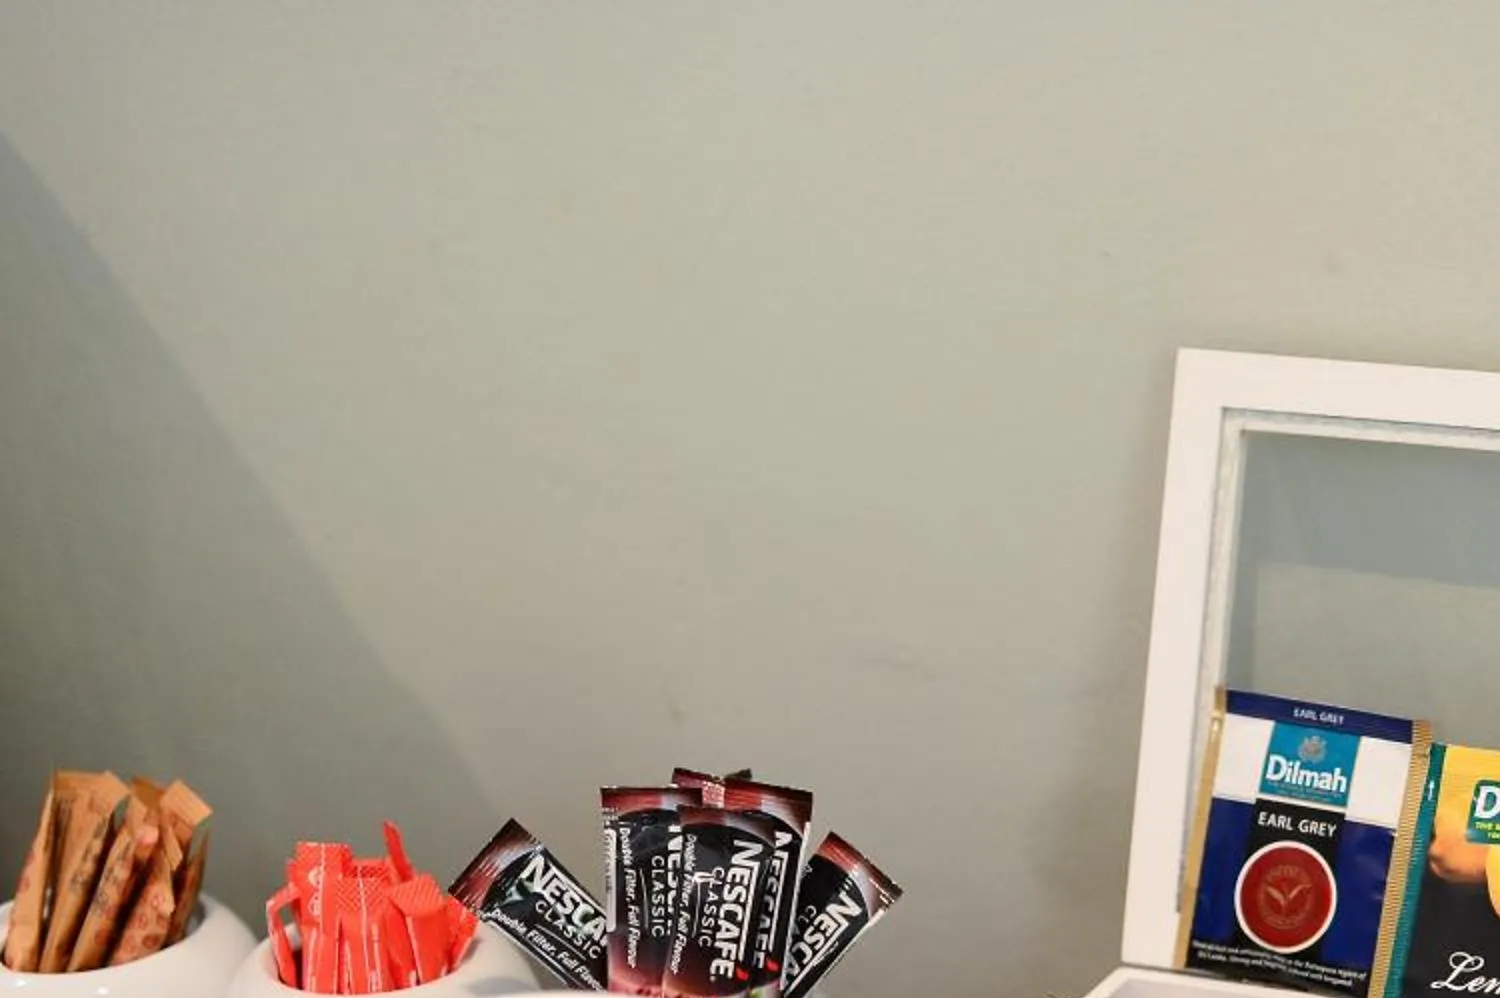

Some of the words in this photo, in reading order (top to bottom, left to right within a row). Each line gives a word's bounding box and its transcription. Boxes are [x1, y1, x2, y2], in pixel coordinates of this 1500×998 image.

[1293, 707, 1317, 720] EARL
[1320, 712, 1344, 724] GREY
[1265, 754, 1347, 792] Dilmah
[1258, 811, 1293, 831] EARL
[1298, 819, 1337, 837] GREY
[1475, 822, 1493, 831] THE
[651, 856, 665, 938] CLASSIC
[699, 866, 725, 948] CLASSIC
[536, 900, 601, 959] CLASSIC
